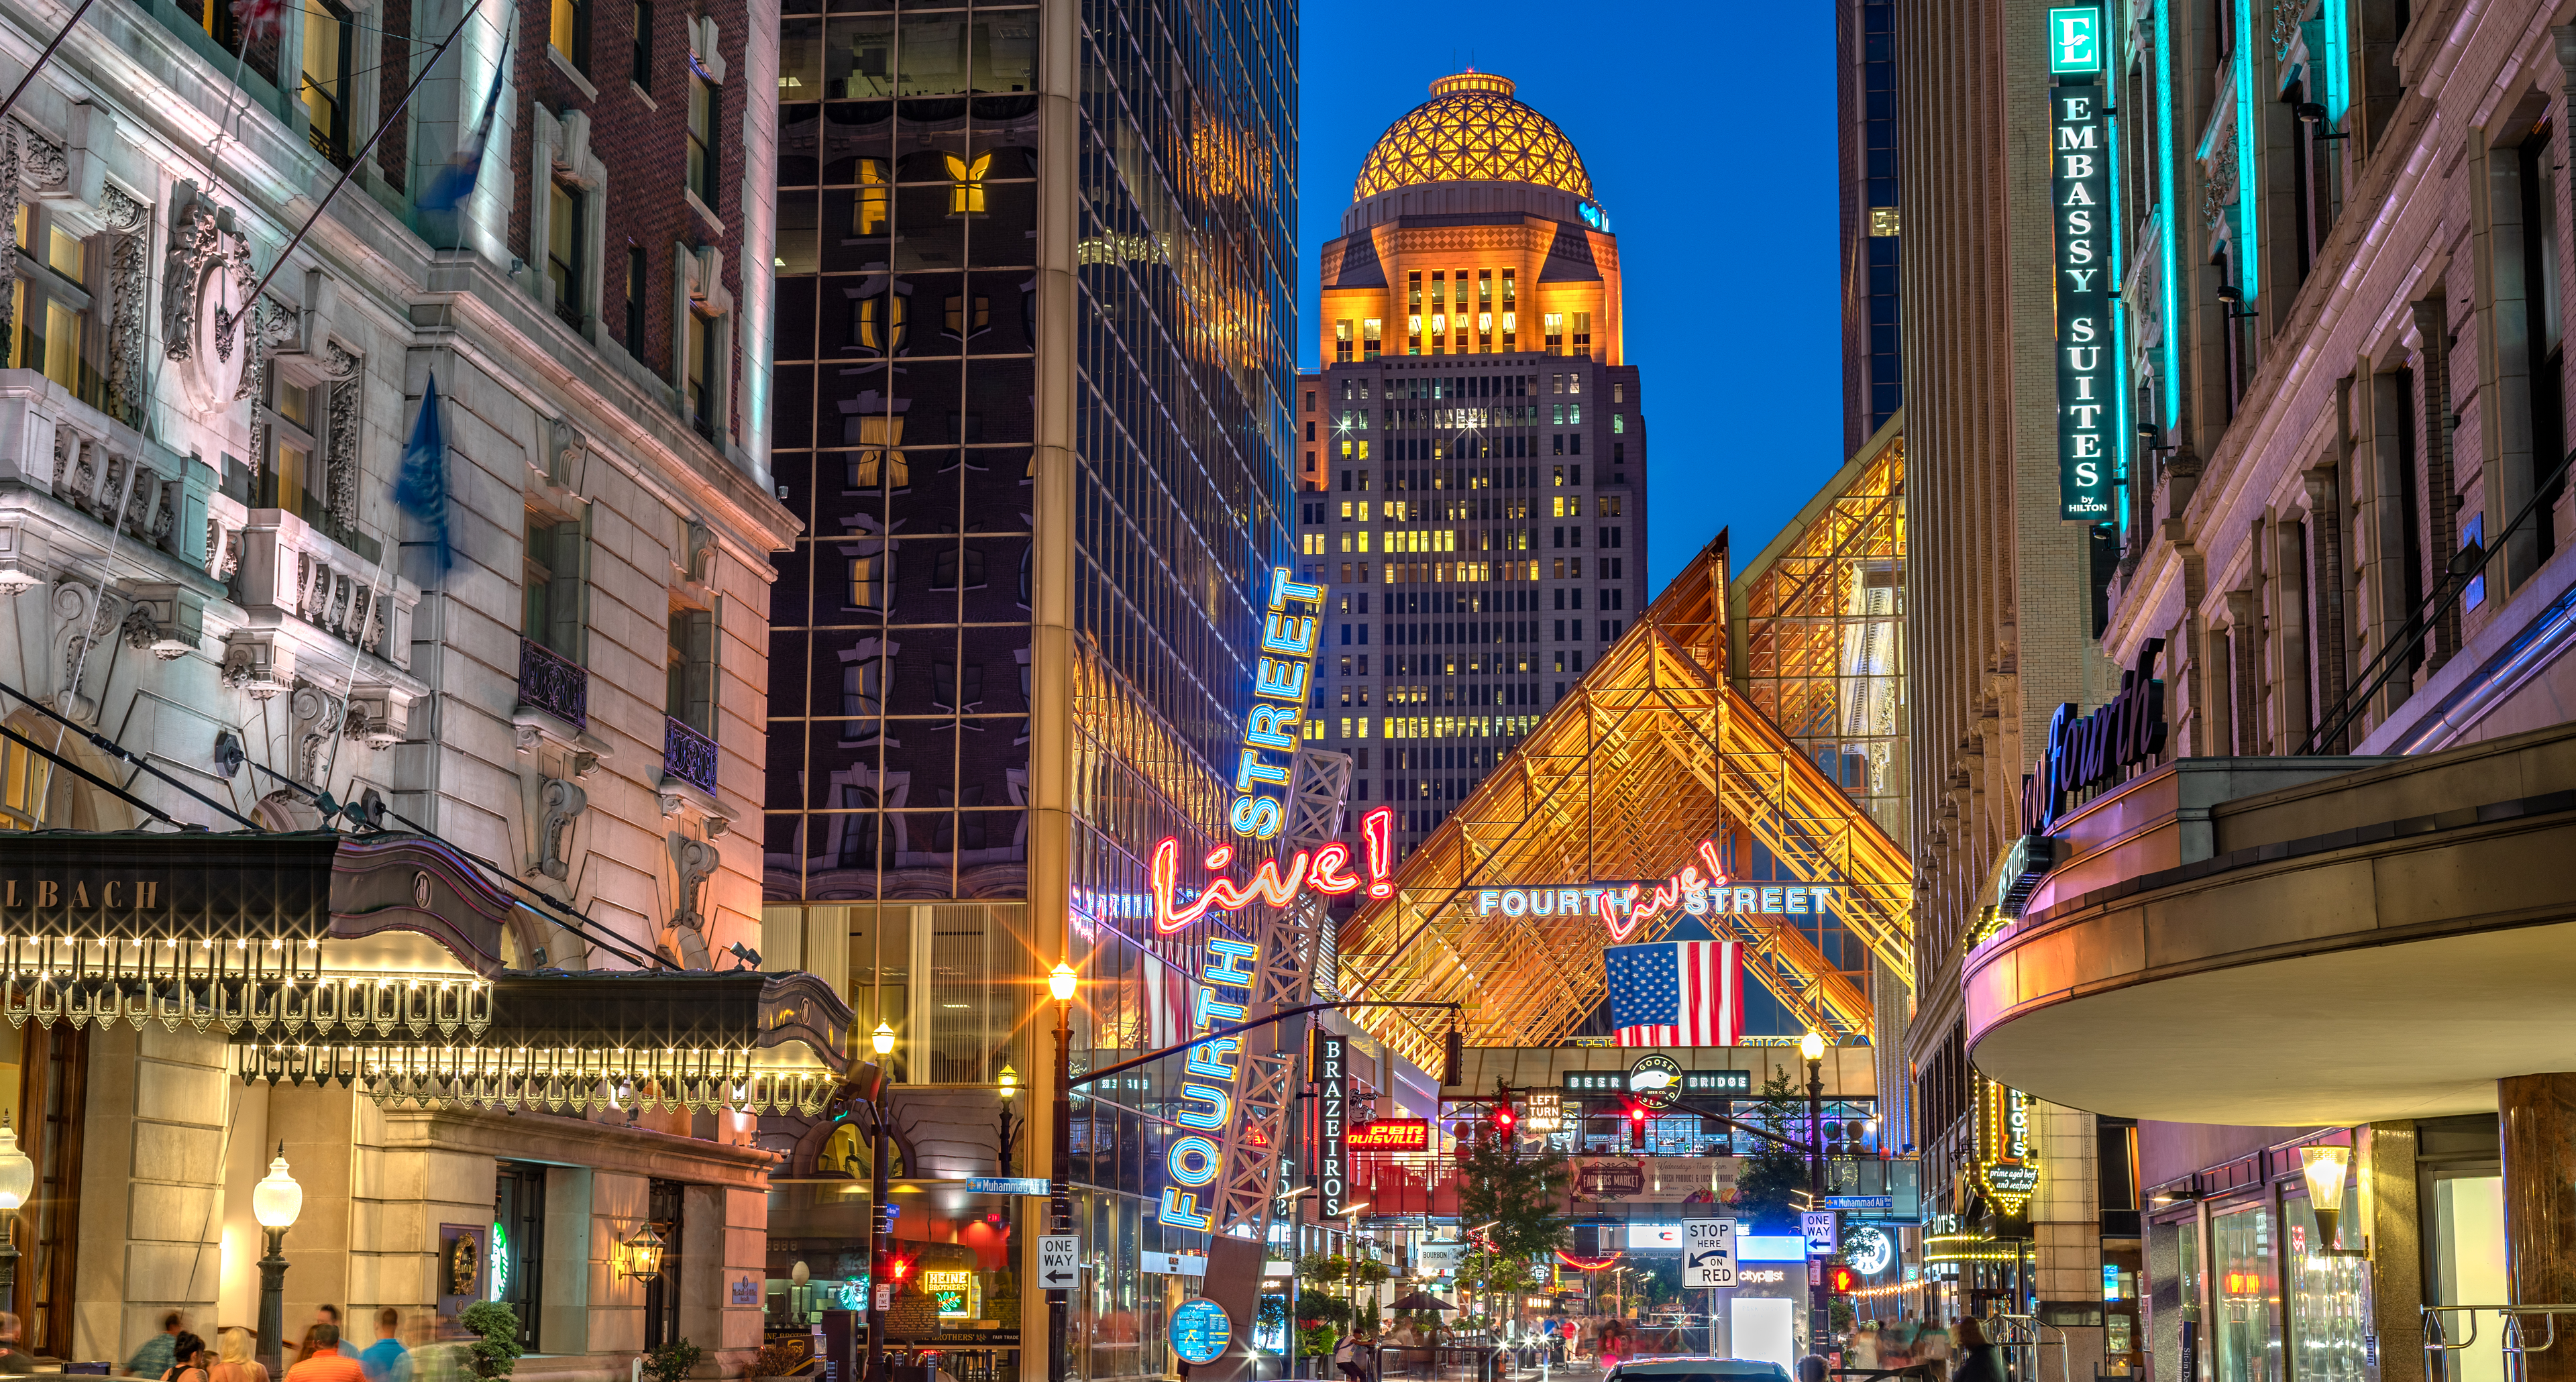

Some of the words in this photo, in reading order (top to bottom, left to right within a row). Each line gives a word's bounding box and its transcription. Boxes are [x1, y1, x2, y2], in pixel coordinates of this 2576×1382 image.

[2057, 97, 2097, 293] EMBASSY
[2066, 317, 2100, 488] SUITES
[2081, 495, 2094, 504] by
[2068, 504, 2107, 512] HILTON
[1230, 566, 1329, 841] STREET
[1150, 805, 1394, 935] Live!
[1599, 840, 1728, 942] Live!
[1479, 889, 1631, 918] FOURTH
[1684, 887, 1833, 914] STREET
[1639, 1059, 1674, 1071] GOOSE
[1159, 936, 1258, 1232] FOURTH
[1571, 1077, 1619, 1087] BEER
[1690, 1077, 1746, 1087] BRIDGE
[1530, 1096, 1558, 1105] LEFT
[1530, 1107, 1559, 1116] TURN
[1324, 1041, 1341, 1216] BRAZEIROS
[1371, 1126, 1424, 1135] PBR
[1655, 1161, 1692, 1172] Wednesdays
[1650, 1174, 1660, 1182] FARM
[1662, 1174, 1674, 1182] FRESH
[1676, 1174, 1694, 1182] PRODUCE
[1701, 1174, 1713, 1182] LOCAL
[1716, 1174, 1733, 1182] VENDORS
[1990, 1168, 2008, 1179] prime
[2008, 1169, 2023, 1179] aged
[2024, 1169, 2037, 1180] beef
[983, 1179, 1028, 1192] Muhammad
[1029, 1180, 1039, 1193] Ali
[1583, 1175, 1611, 1187] FARMERS
[1613, 1175, 1639, 1187] MARKET
[1996, 1179, 2009, 1188] and
[2009, 1181, 2032, 1191] seafood
[1839, 1198, 1874, 1207] Muhammad
[1875, 1198, 1884, 1206] Ali
[1808, 1216, 1829, 1225] ONE
[1690, 1224, 1728, 1237] STOP
[1807, 1226, 1830, 1236] WAY
[1045, 1240, 1072, 1252] ONE
[1044, 1255, 1073, 1266] WAY
[929, 1273, 967, 1283] HEINE
[1703, 1269, 1731, 1281] RED
